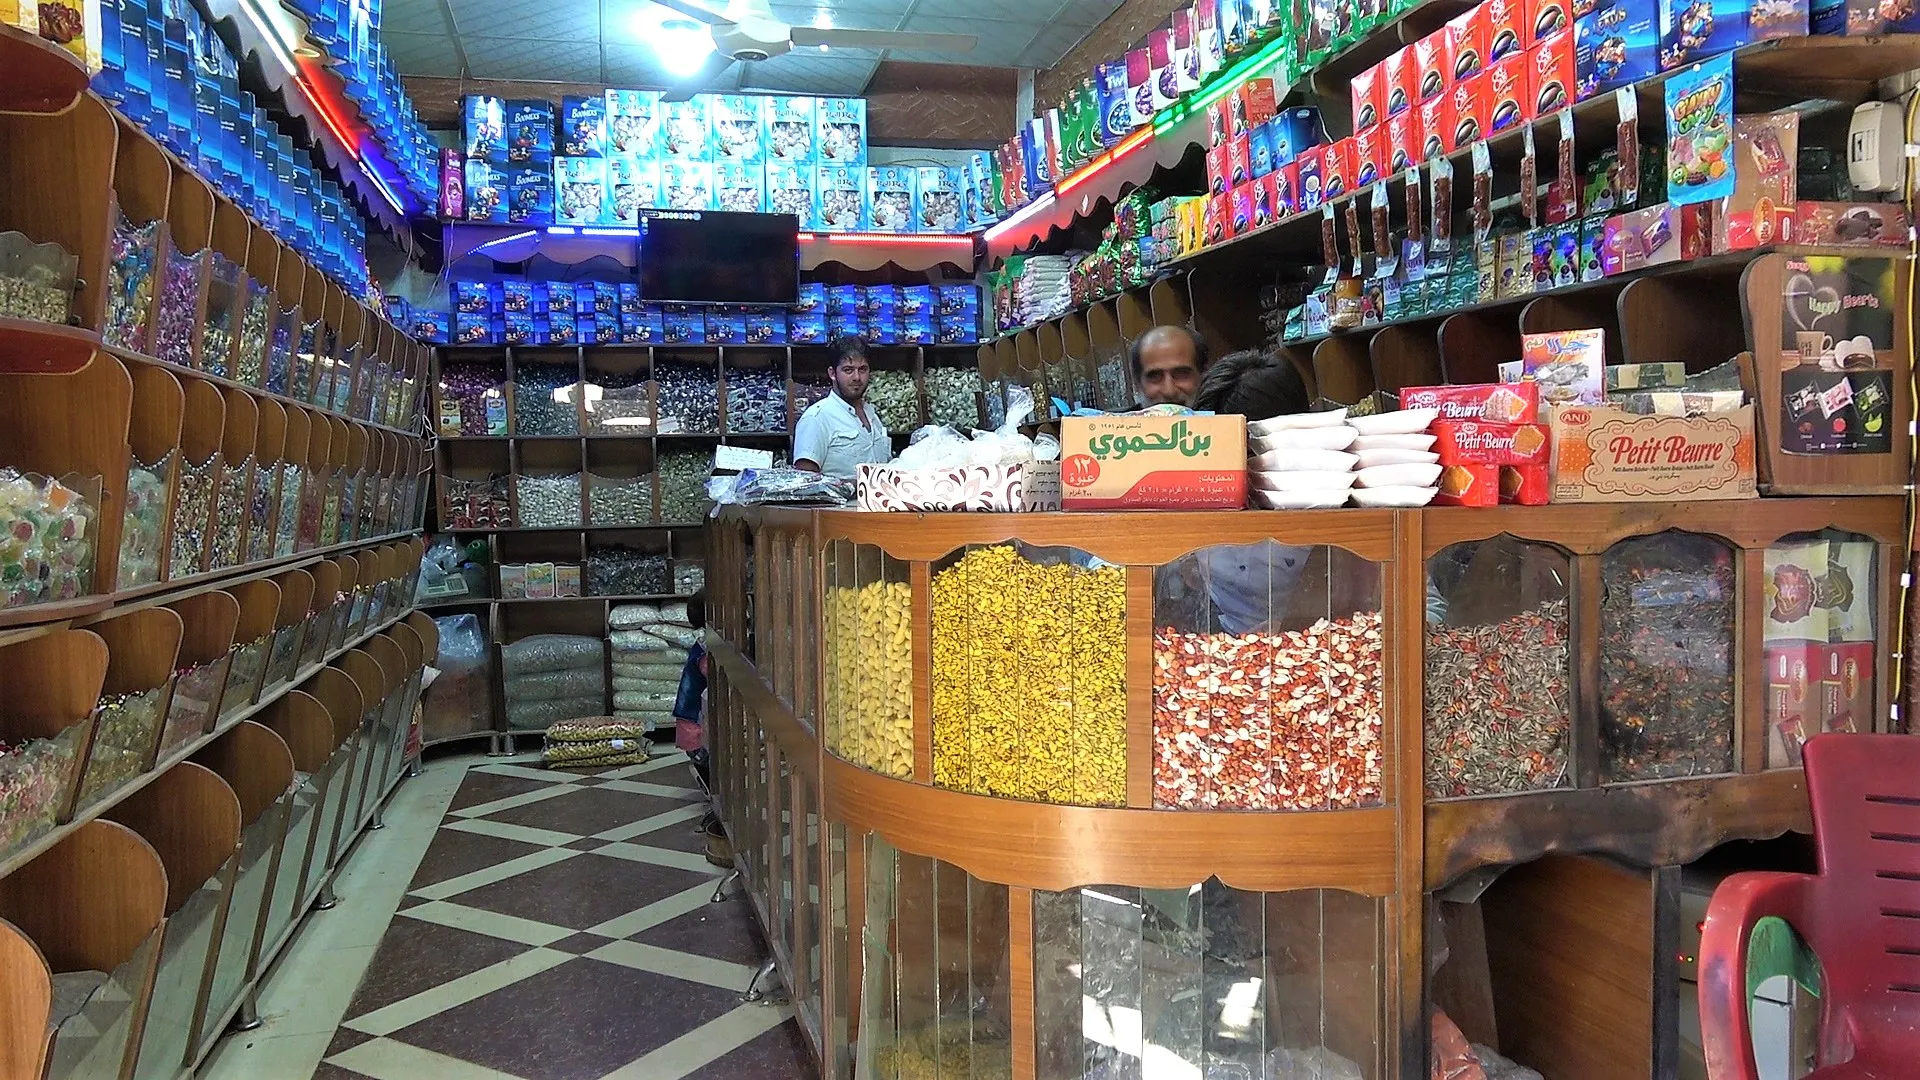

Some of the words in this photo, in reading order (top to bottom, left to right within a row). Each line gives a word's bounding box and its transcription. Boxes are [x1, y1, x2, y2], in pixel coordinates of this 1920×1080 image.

[1809, 297, 1841, 315] Happy
[1442, 402, 1486, 418] Beurre
[1088, 420, 1187, 460] الحموي
[1180, 431, 1212, 457] بن
[1456, 433, 1482, 449] Petit
[1482, 432, 1516, 449] Beurre
[1609, 436, 1662, 465] Petit
[1663, 435, 1723, 463] Beurre
[1073, 457, 1092, 474] ١٢
[1069, 473, 1096, 486] عبوة
